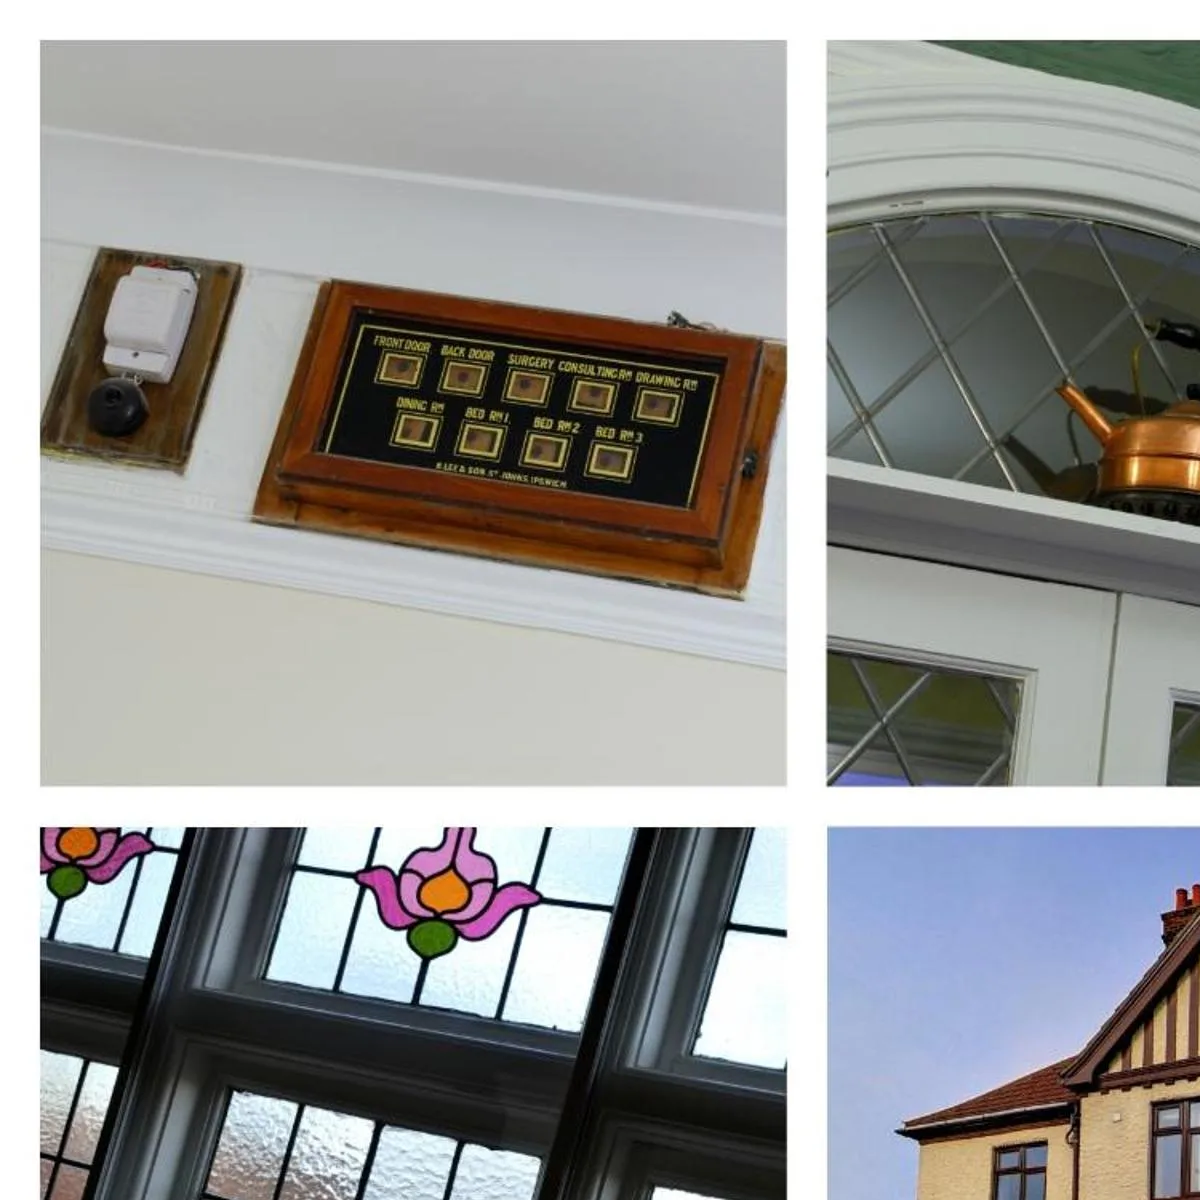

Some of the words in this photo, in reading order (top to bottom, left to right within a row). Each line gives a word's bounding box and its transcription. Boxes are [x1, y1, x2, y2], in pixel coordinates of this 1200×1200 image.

[373, 335, 403, 349] FRONT
[404, 339, 431, 352] DOOR
[440, 345, 465, 358] BACK
[468, 348, 495, 361] DOOR
[507, 353, 555, 370] SURGERY
[558, 360, 618, 379] CONSULTING
[635, 371, 681, 388] DRAWING
[396, 396, 427, 411] DINING
[464, 407, 485, 420] BED
[533, 416, 552, 430] BED
[571, 422, 581, 434] 2
[595, 426, 615, 439] BED
[635, 431, 644, 443] 3
